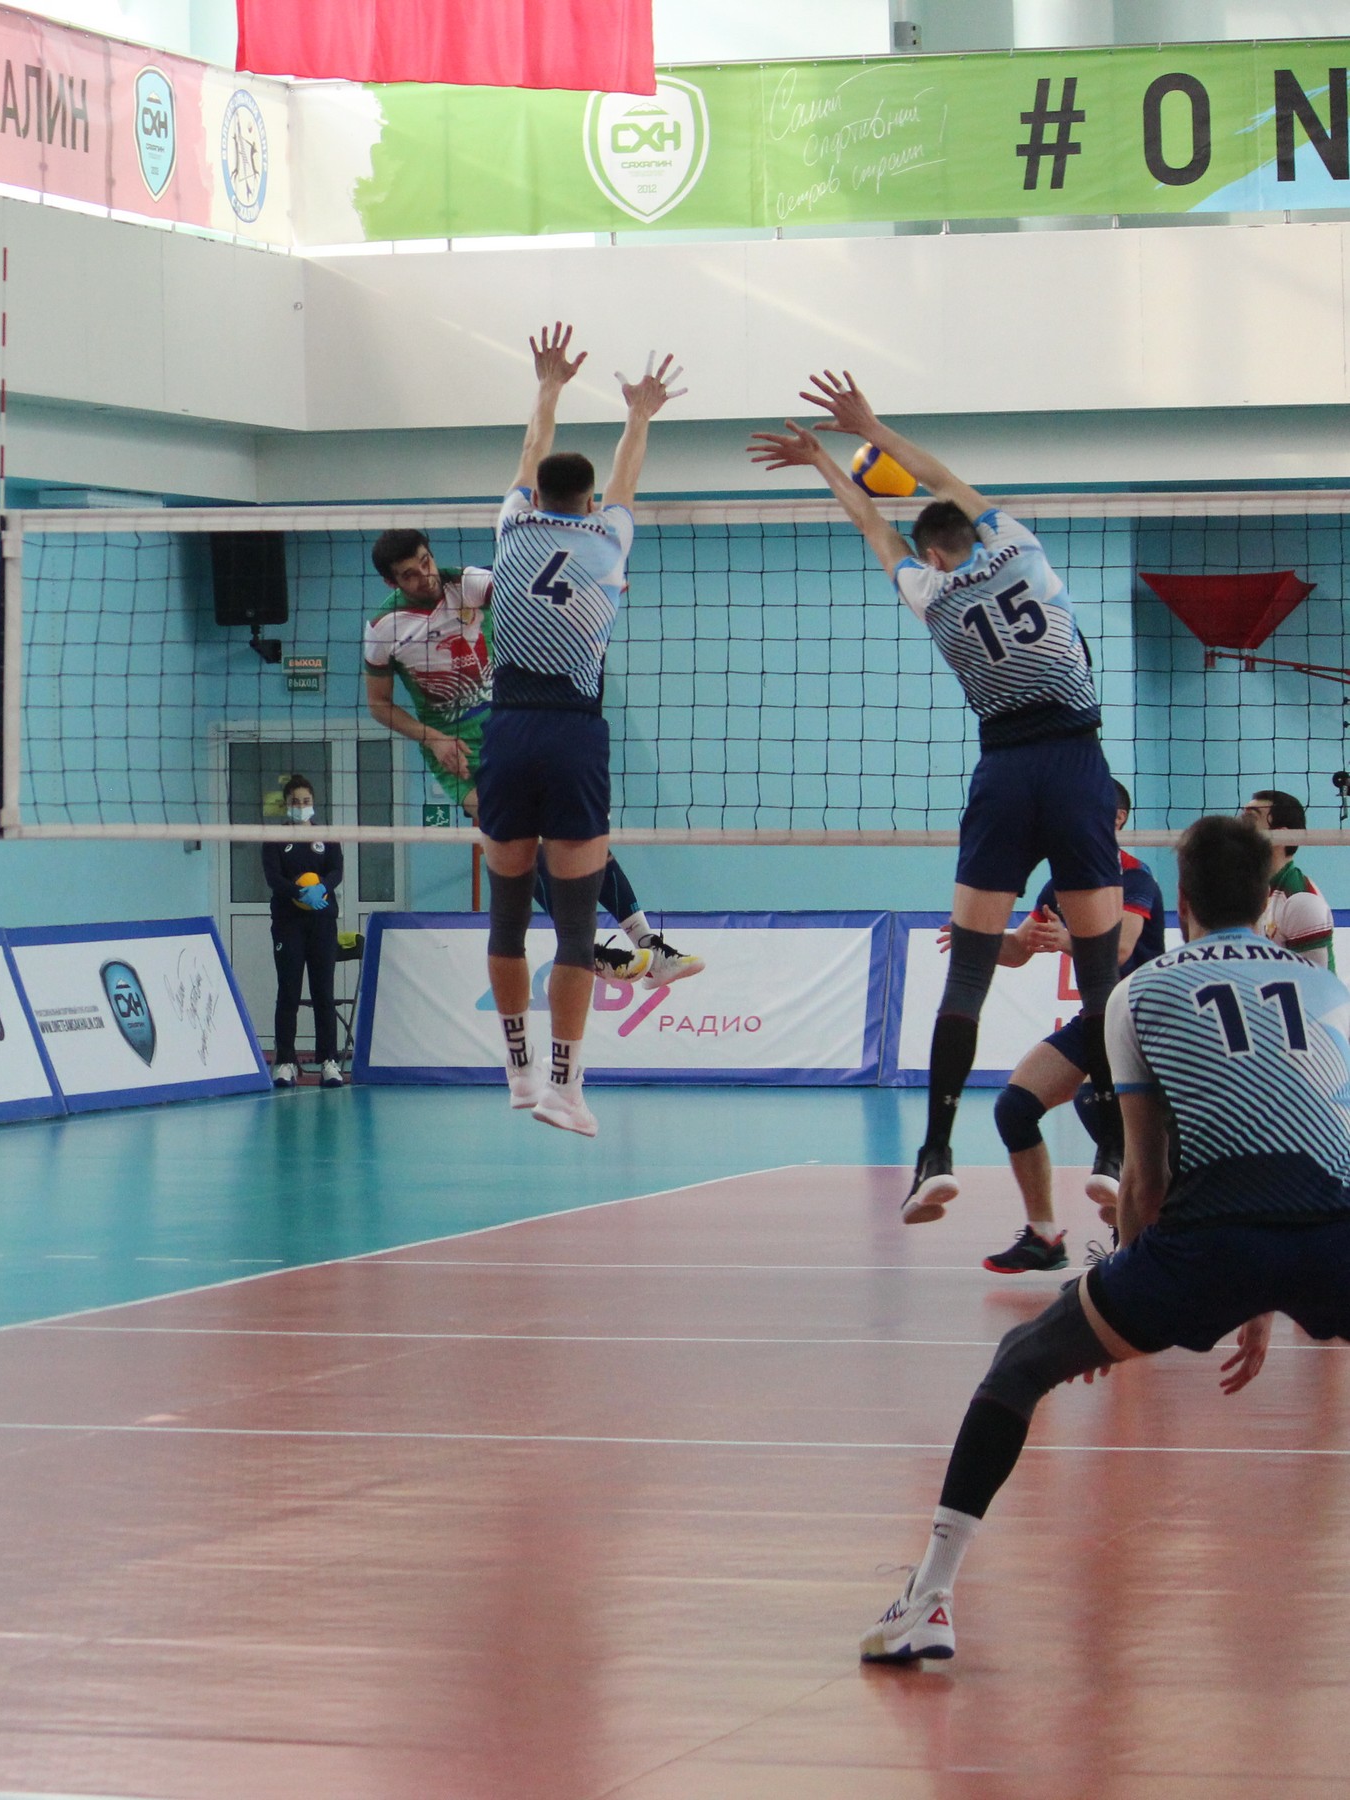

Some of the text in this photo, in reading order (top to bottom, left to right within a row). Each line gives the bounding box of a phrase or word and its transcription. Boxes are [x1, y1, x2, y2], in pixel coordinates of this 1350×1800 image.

[637, 184, 657, 194] 2012
[531, 550, 574, 606] 4
[962, 579, 1048, 664] 15
[288, 659, 323, 667] ВЫХОД
[288, 679, 318, 688] ВЫХОД
[659, 1015, 762, 1036] РАДИО
[1192, 981, 1309, 1055] 11
